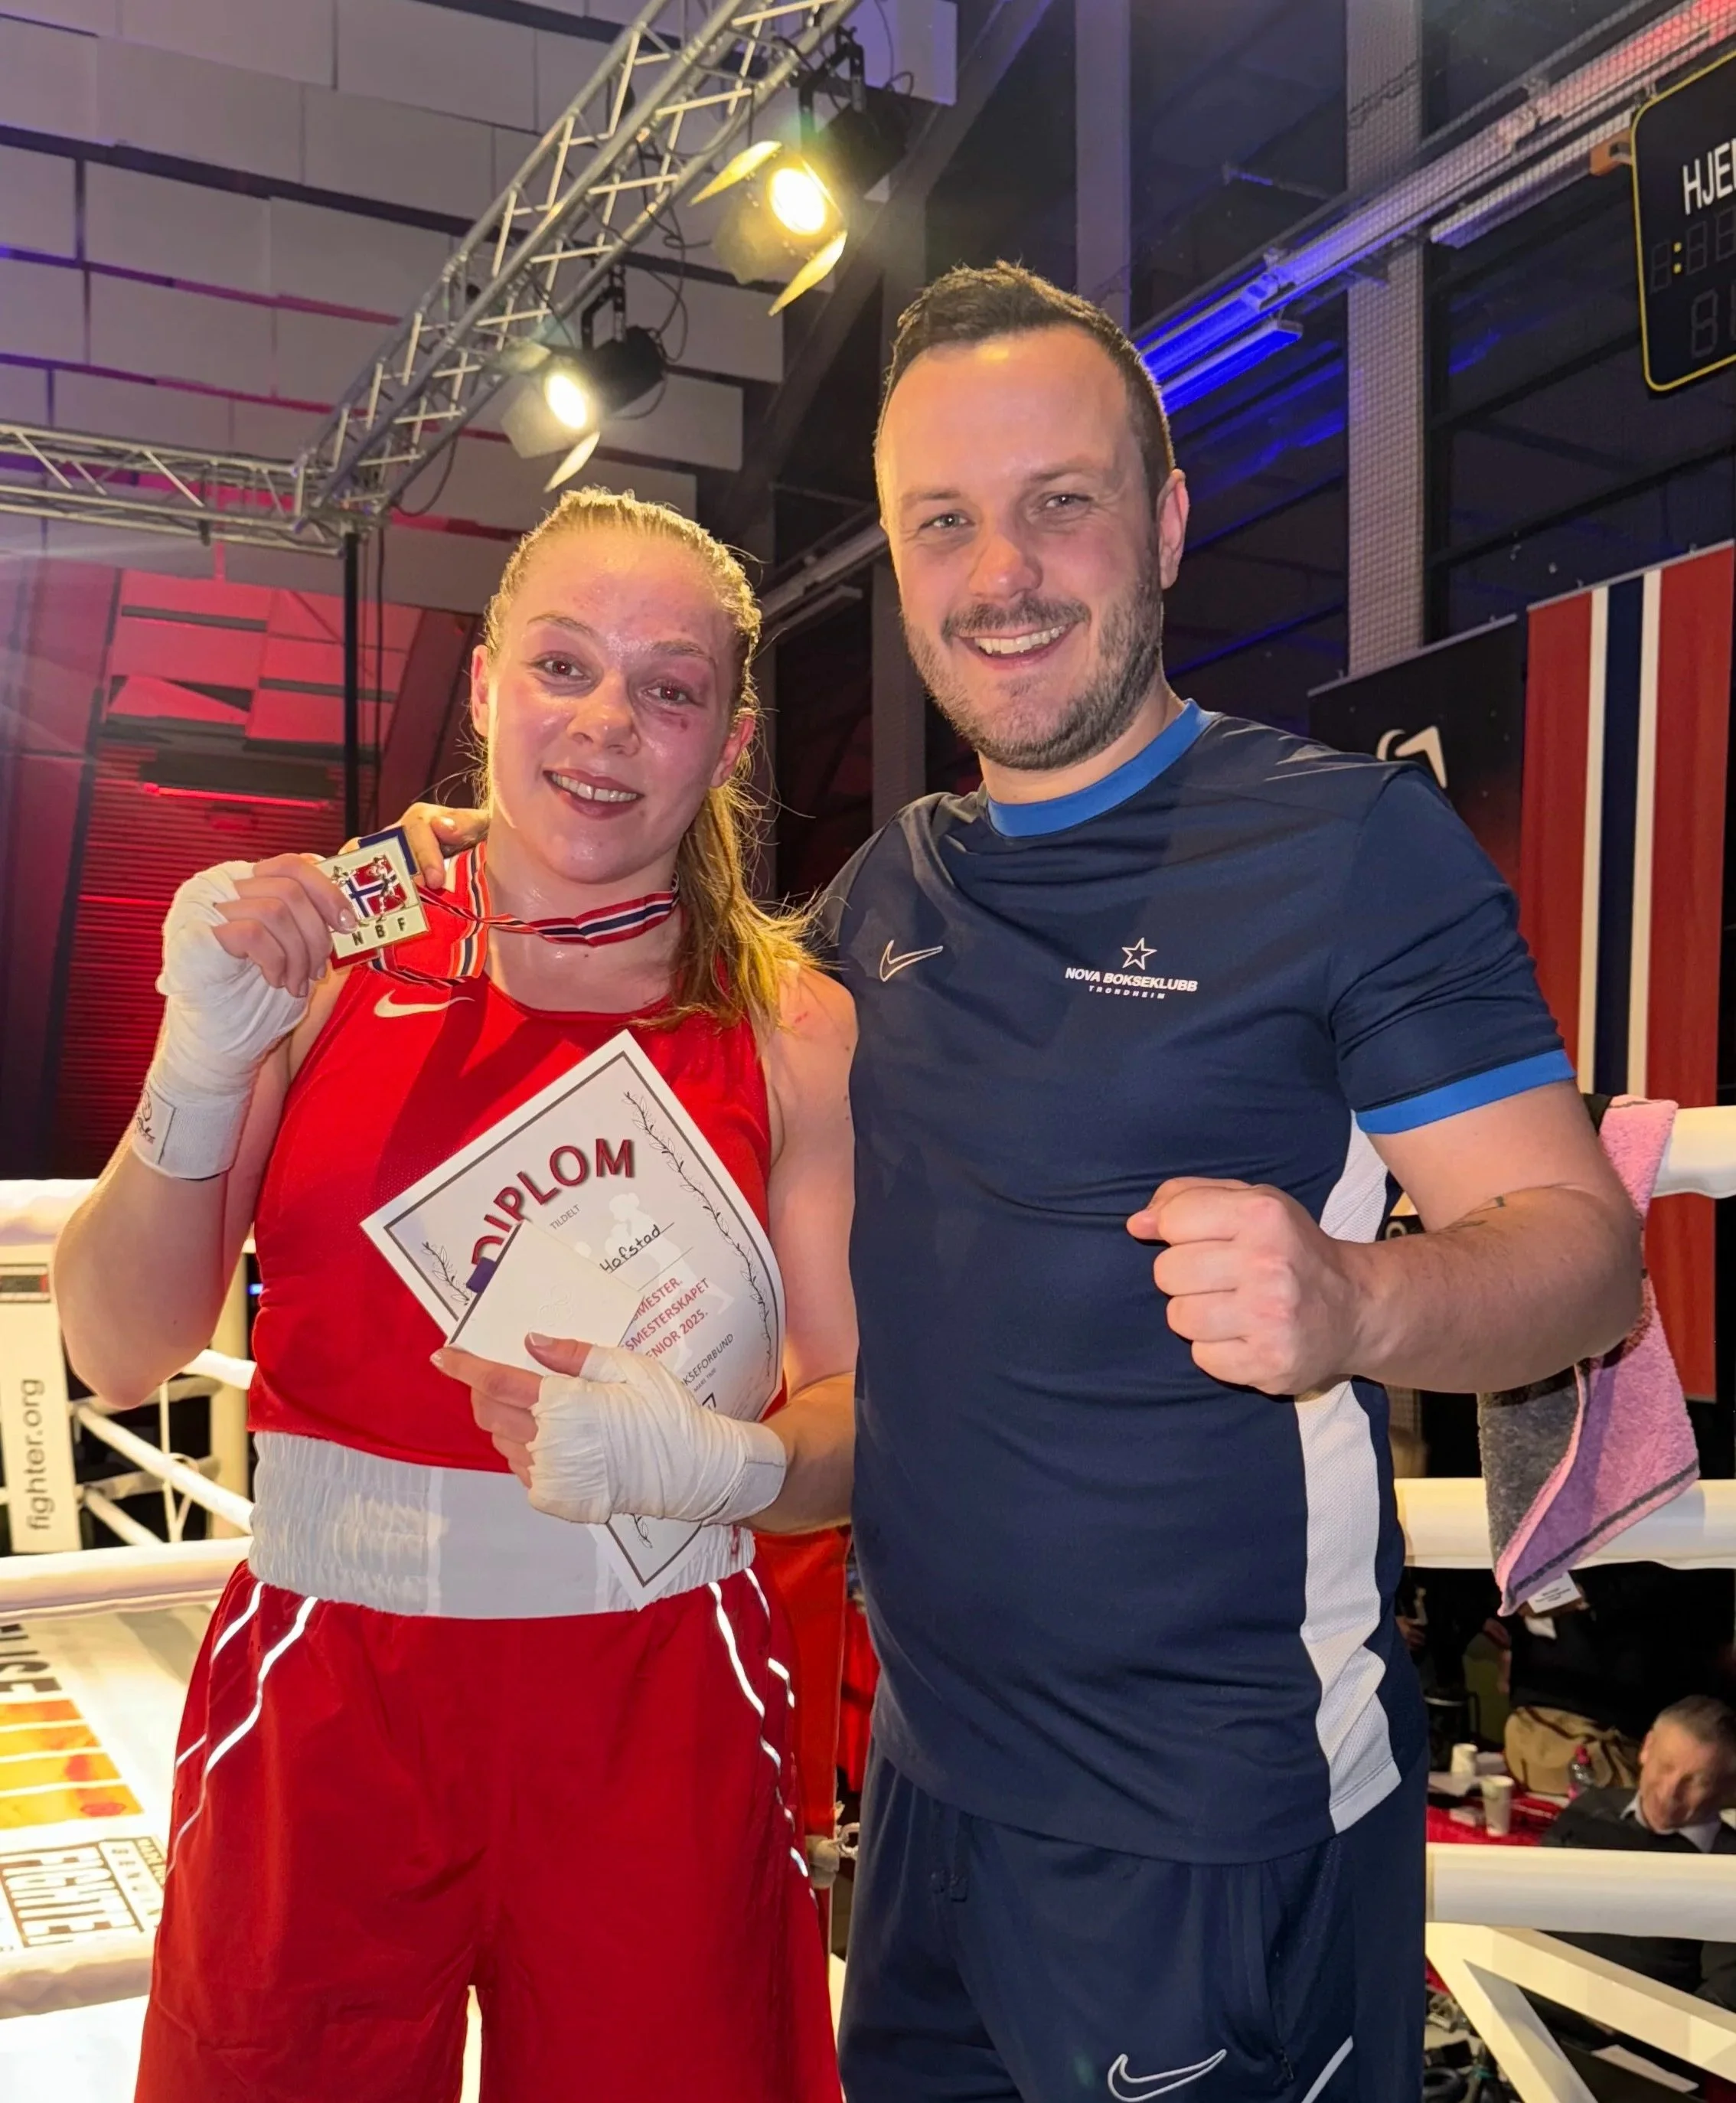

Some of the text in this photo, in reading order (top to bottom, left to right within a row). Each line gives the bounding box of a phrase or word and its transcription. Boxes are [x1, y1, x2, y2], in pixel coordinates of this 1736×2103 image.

[1682, 138, 1736, 215] HJE
[1065, 967, 1199, 992] NOVA BOKSEKLUBB
[1088, 985, 1166, 1000] TRONDHEIM
[550, 1204, 580, 1230] TILDELT
[625, 1255, 710, 1351] SMESTERSKAPET
[645, 1331, 681, 1360] ENIOR
[682, 1334, 733, 1386] KSEFORBUND
[21, 1379, 55, 1531] fighter.org
